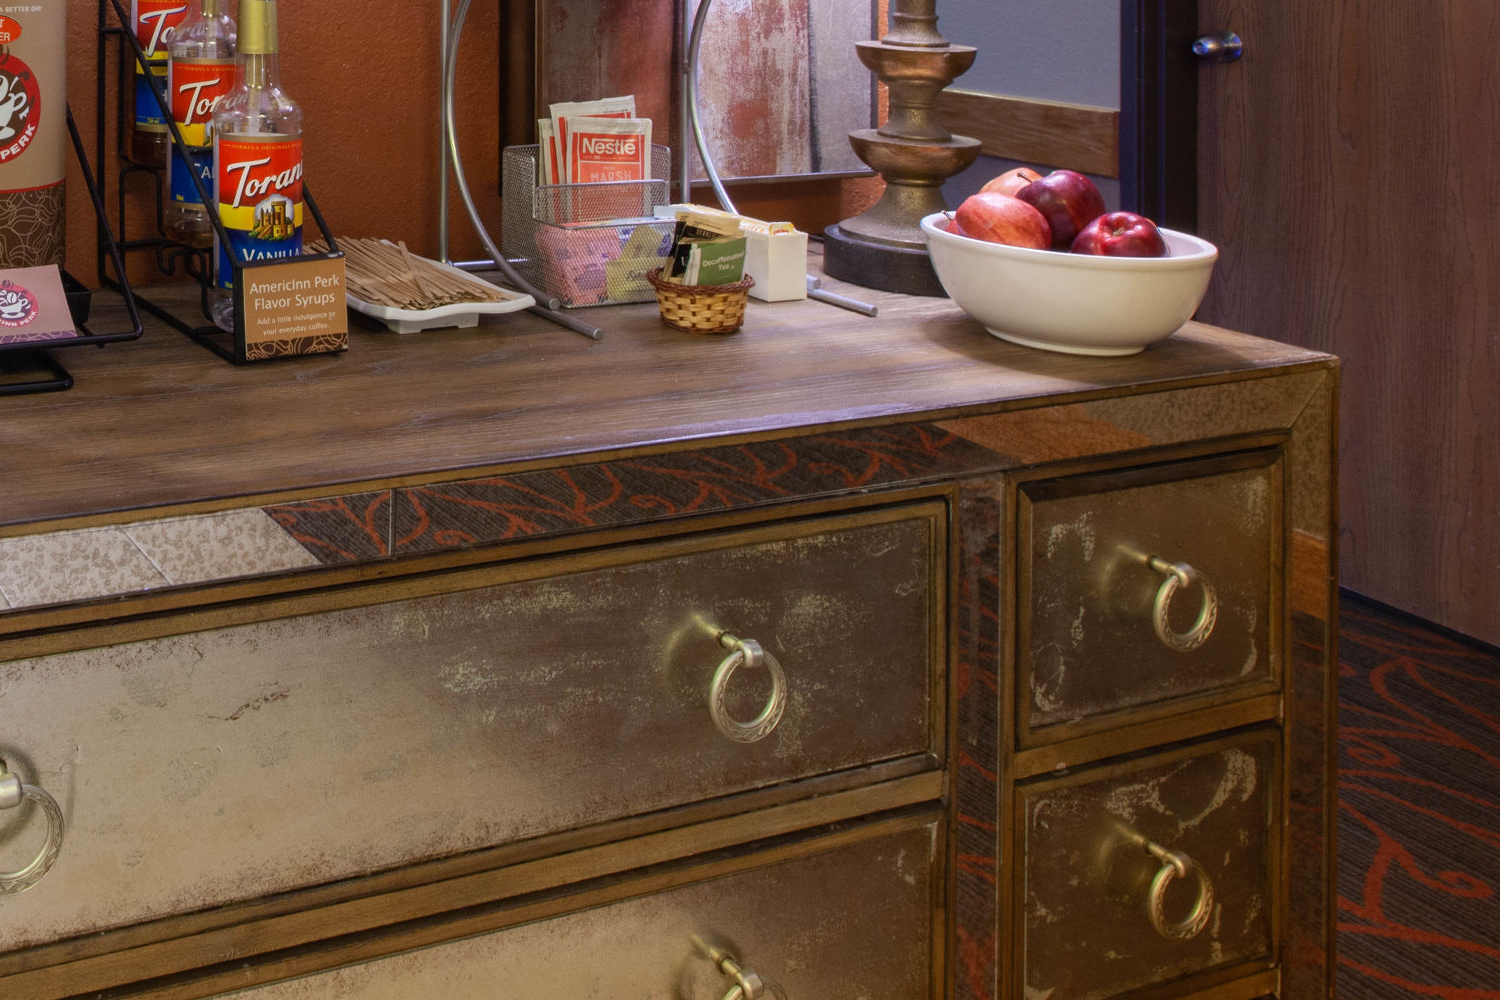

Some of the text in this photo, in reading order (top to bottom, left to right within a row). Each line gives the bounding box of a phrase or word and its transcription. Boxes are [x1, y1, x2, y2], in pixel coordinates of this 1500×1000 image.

[0, 123, 36, 161] PERK
[249, 279, 311, 295] AmericInn
[314, 274, 340, 288] Perk
[254, 293, 336, 311] Flavor Syrups
[257, 317, 270, 325] Add
[278, 315, 292, 323] little
[293, 311, 328, 322] indulgence
[263, 322, 330, 336] your everyday coffee.
